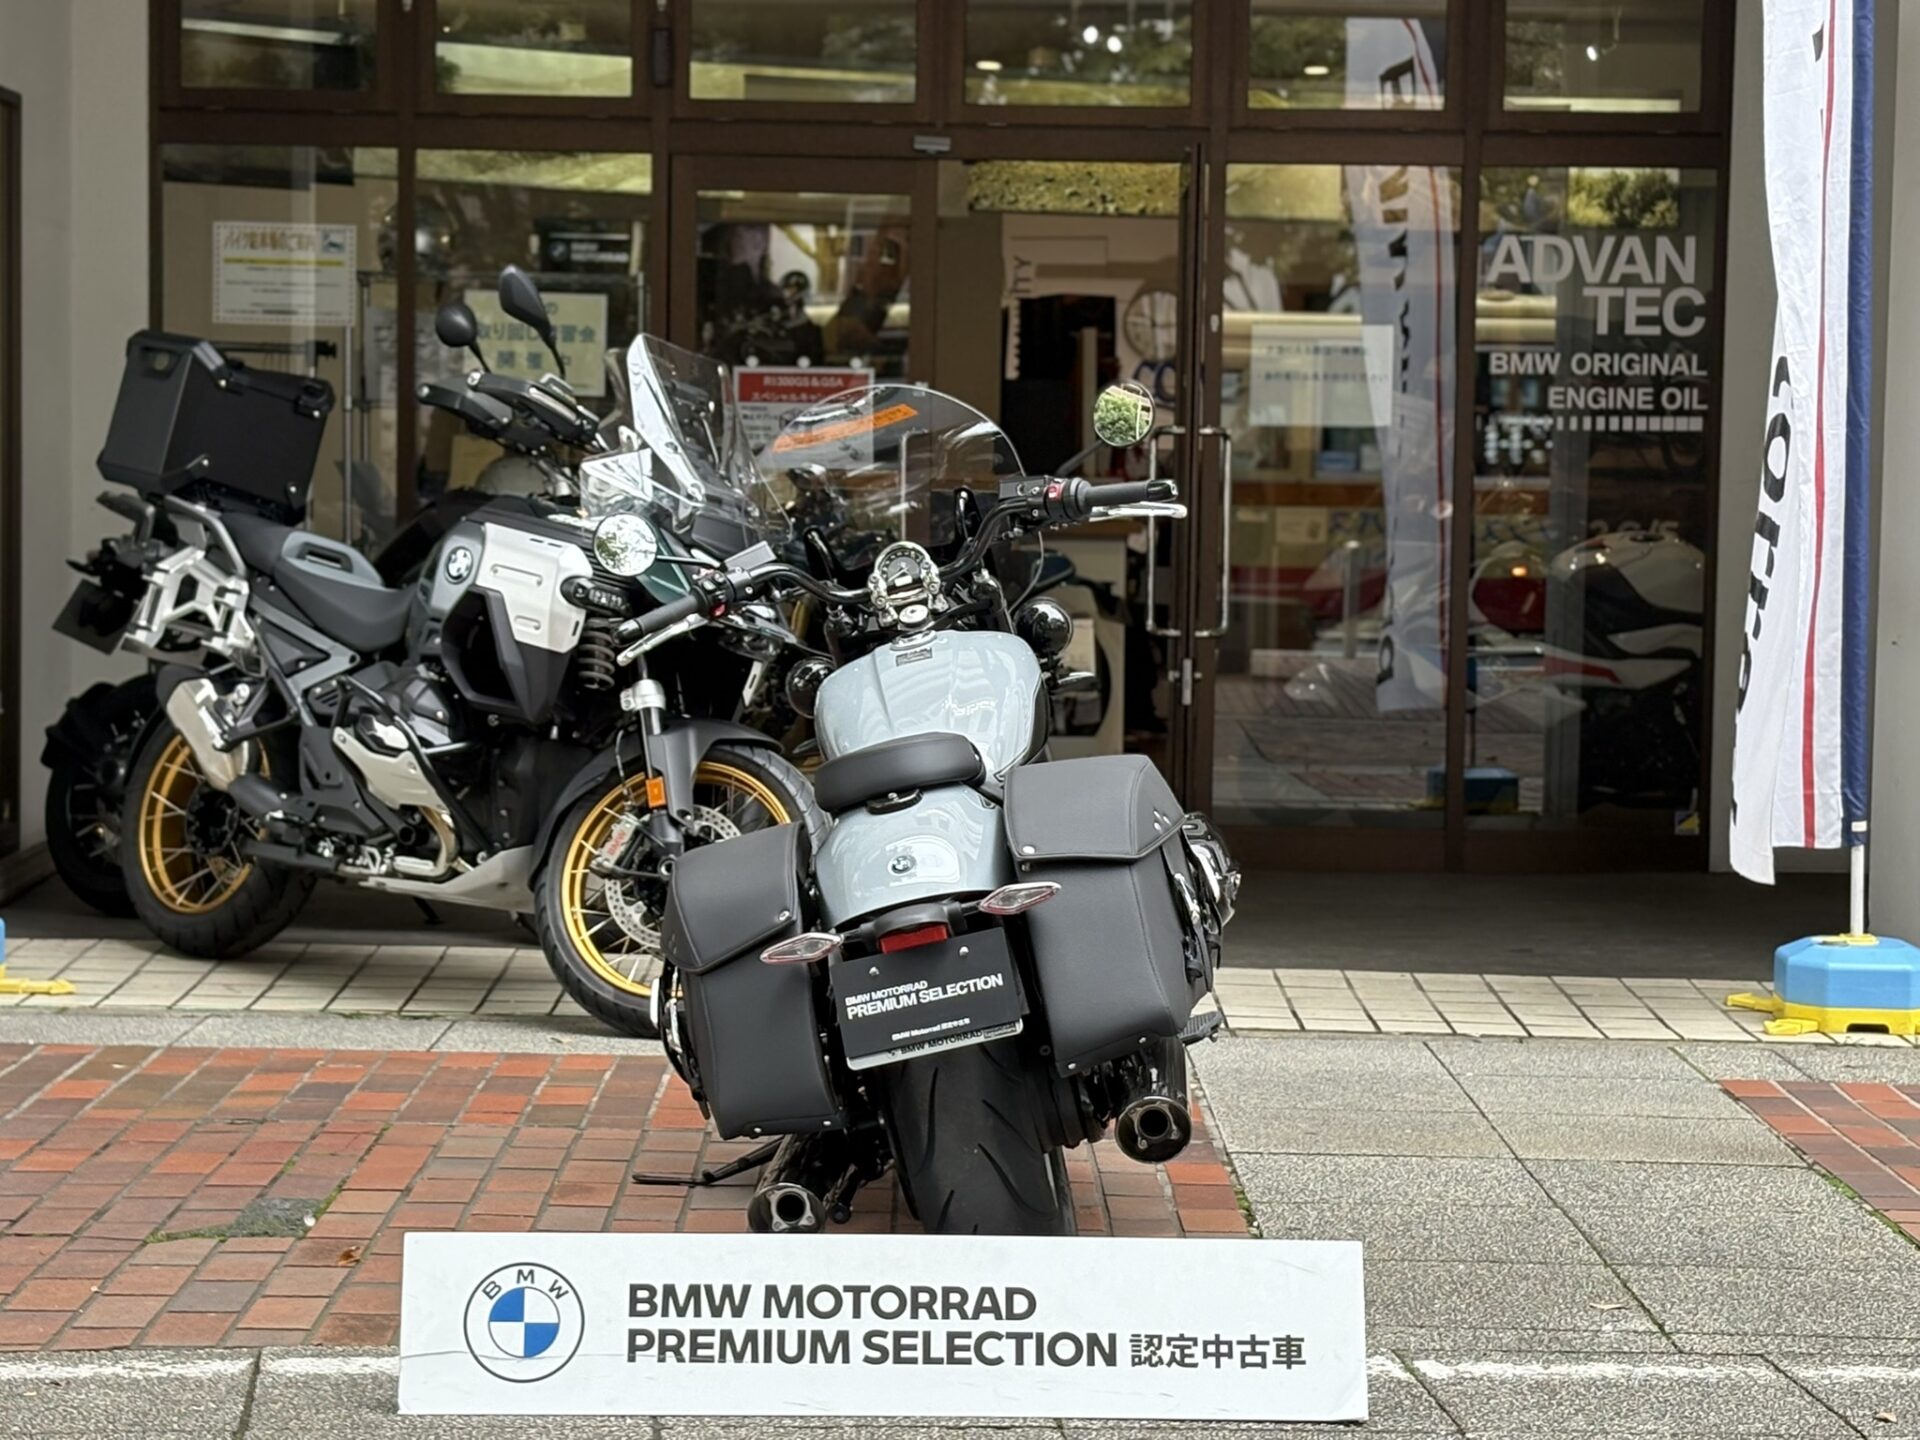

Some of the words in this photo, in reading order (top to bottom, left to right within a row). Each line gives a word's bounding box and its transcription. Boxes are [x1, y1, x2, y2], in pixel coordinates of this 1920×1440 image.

[1485, 235, 1697, 285] ADVAN
[1583, 286, 1707, 337] TEC
[475, 323, 596, 343] 取り回し習会
[1489, 353, 1561, 375] BMW
[1570, 353, 1708, 376] ORIGINAL
[1547, 387, 1654, 410] ENGINE
[1661, 387, 1709, 410] OIL
[845, 993, 871, 1006] BMW
[871, 980, 929, 1000] MOTORRAD
[846, 994, 918, 1020] PREMIUM
[919, 973, 1005, 1003] SELECTION
[628, 1283, 751, 1319] BMW
[763, 1284, 1037, 1321] MOTORRAD
[626, 1328, 851, 1364] PREMIUM
[862, 1330, 1117, 1367] SELECTION
[1129, 1333, 1307, 1370] 認定中古車
